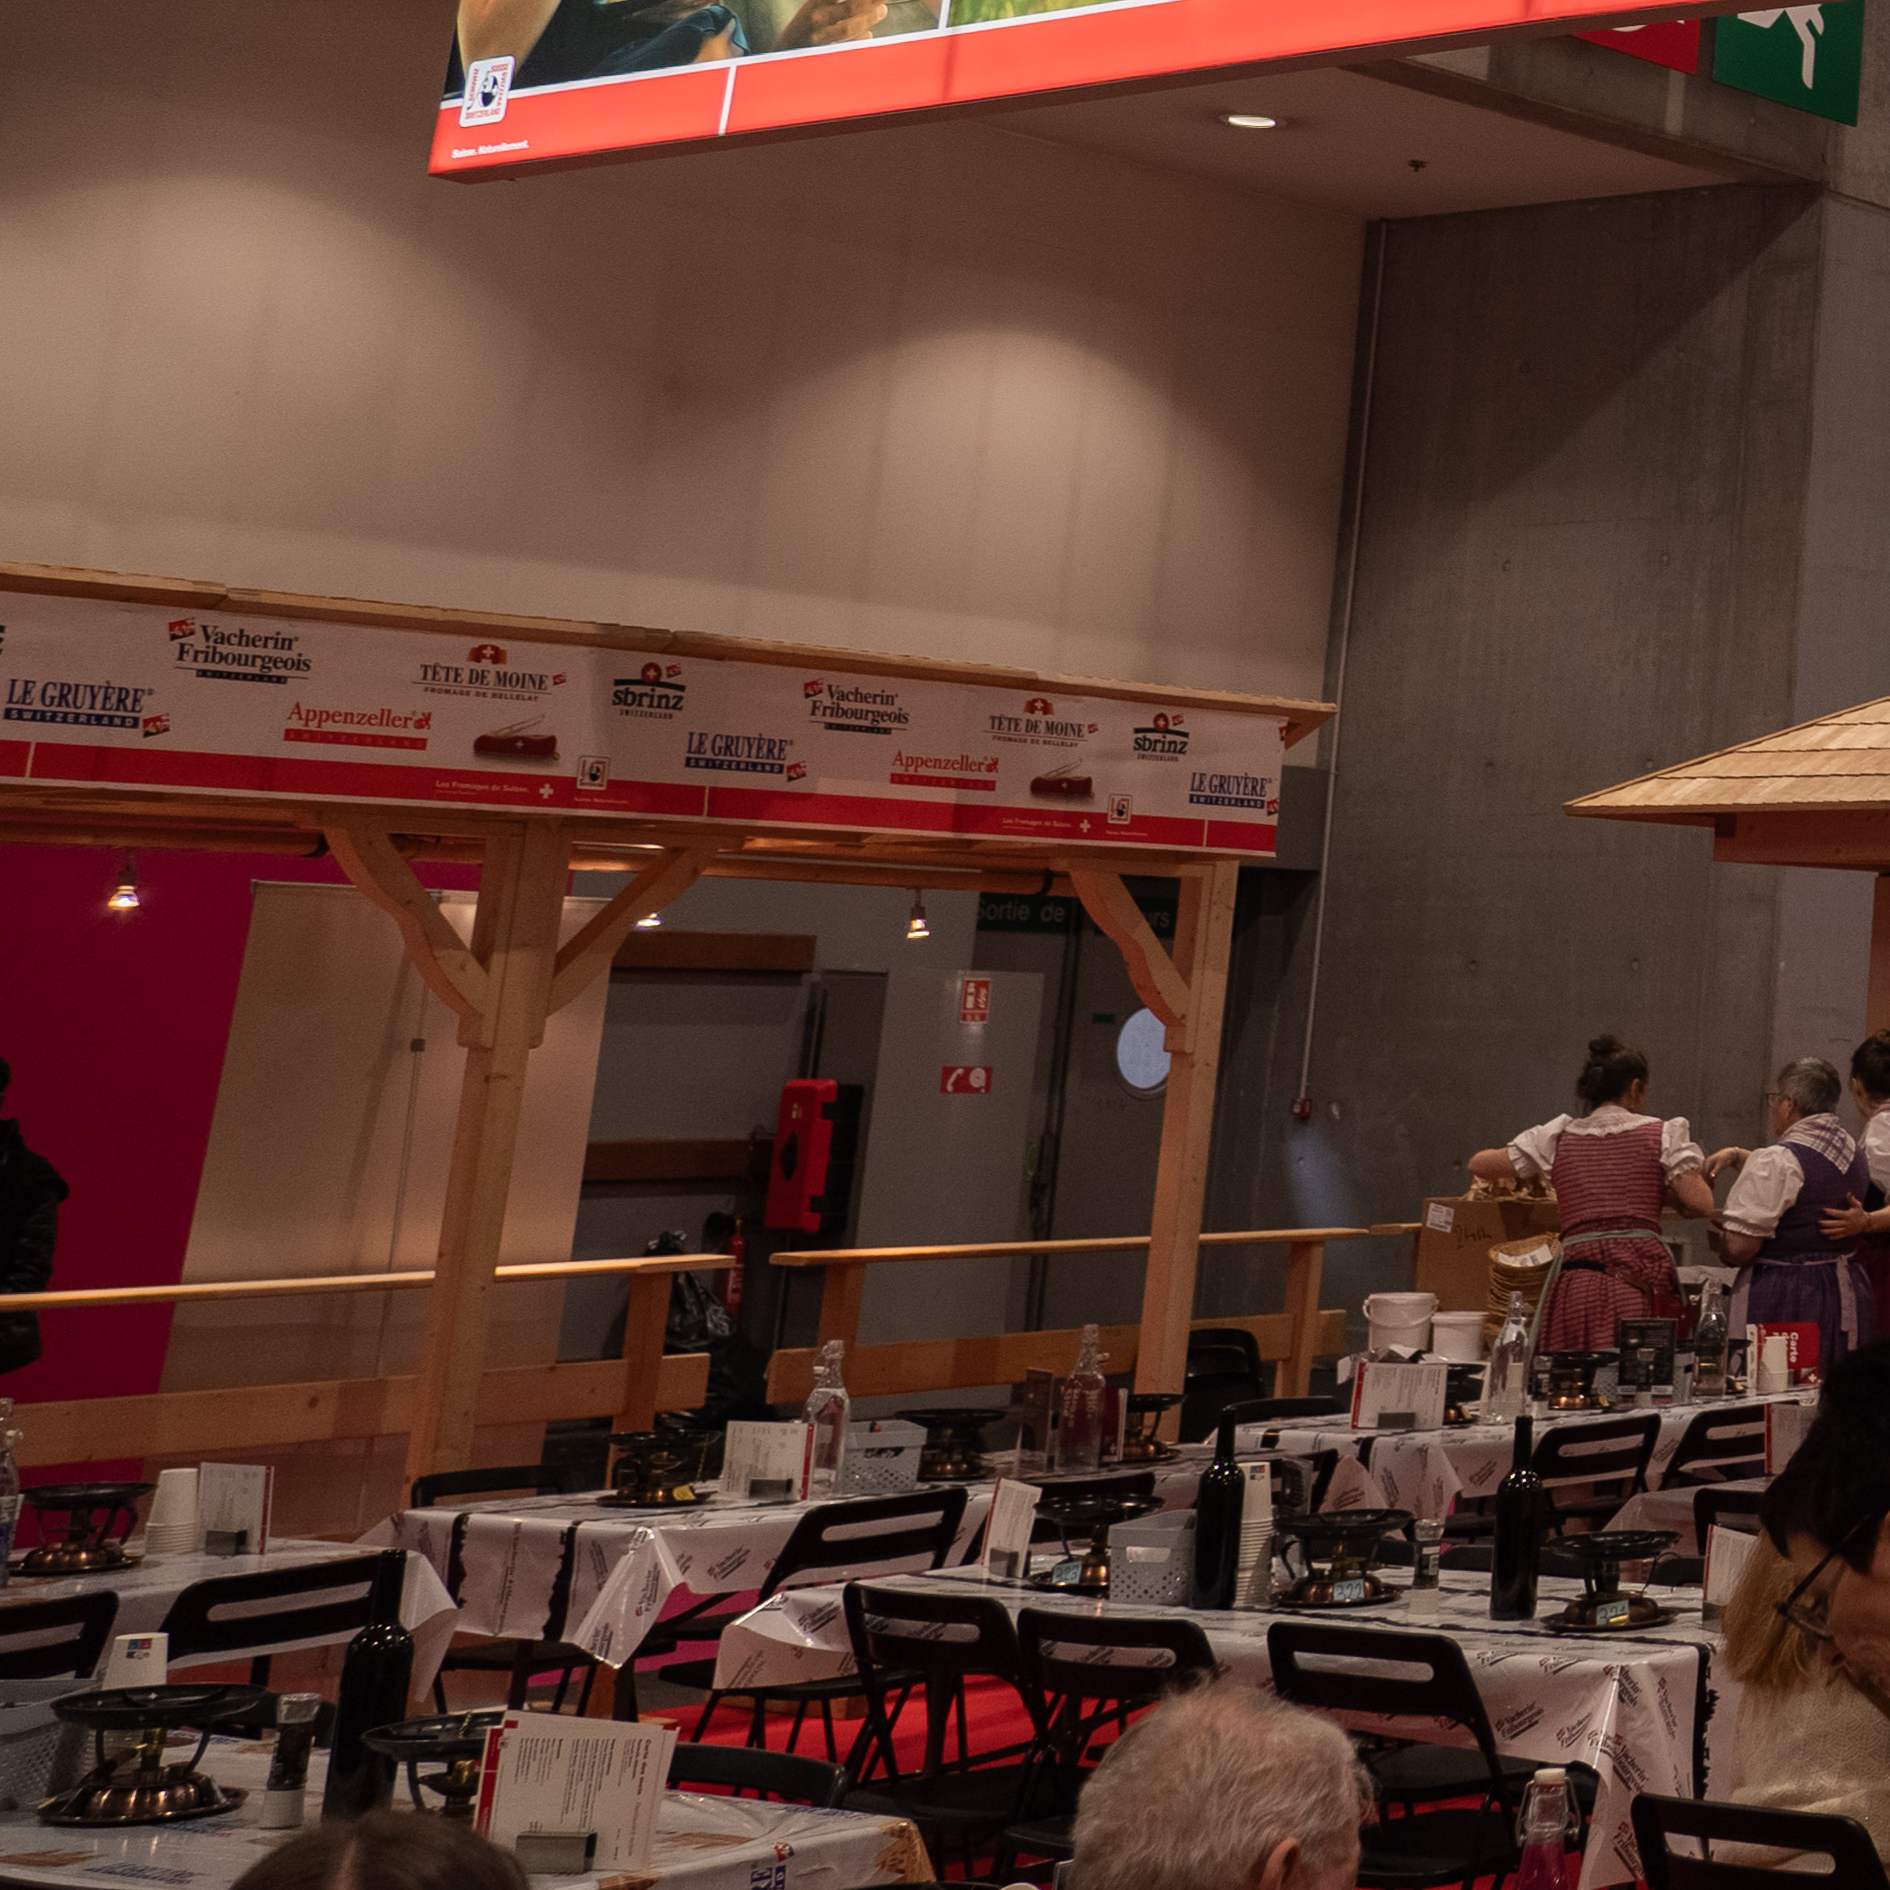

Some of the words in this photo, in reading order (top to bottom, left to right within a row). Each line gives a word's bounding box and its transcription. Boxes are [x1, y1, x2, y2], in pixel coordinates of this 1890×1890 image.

[200, 624, 295, 651] Vacherin
[176, 643, 312, 673] Fribourgeois
[420, 663, 464, 684] TÊTE
[468, 667, 491, 686] DE
[494, 670, 549, 692] MOINE
[6, 678, 36, 707] LE
[41, 681, 145, 713] GRUYÈRE
[612, 687, 684, 711] sbrinz
[826, 684, 896, 706] Vacherin
[9, 710, 135, 728] SWITZERLAND
[287, 702, 414, 730] Appenzeller
[809, 700, 910, 726] Fribourgeois
[989, 712, 1023, 732] TÊTE
[1025, 718, 1042, 734] DE
[1044, 721, 1085, 739] MOINE
[687, 732, 708, 755] LE
[711, 733, 788, 761] GRUYÈRE
[1133, 733, 1188, 756] sbrinz
[892, 750, 985, 775] Appenzeller
[1191, 772, 1207, 794] LE
[1209, 773, 1268, 798] GRUYÈRE
[1041, 898, 1065, 923] de
